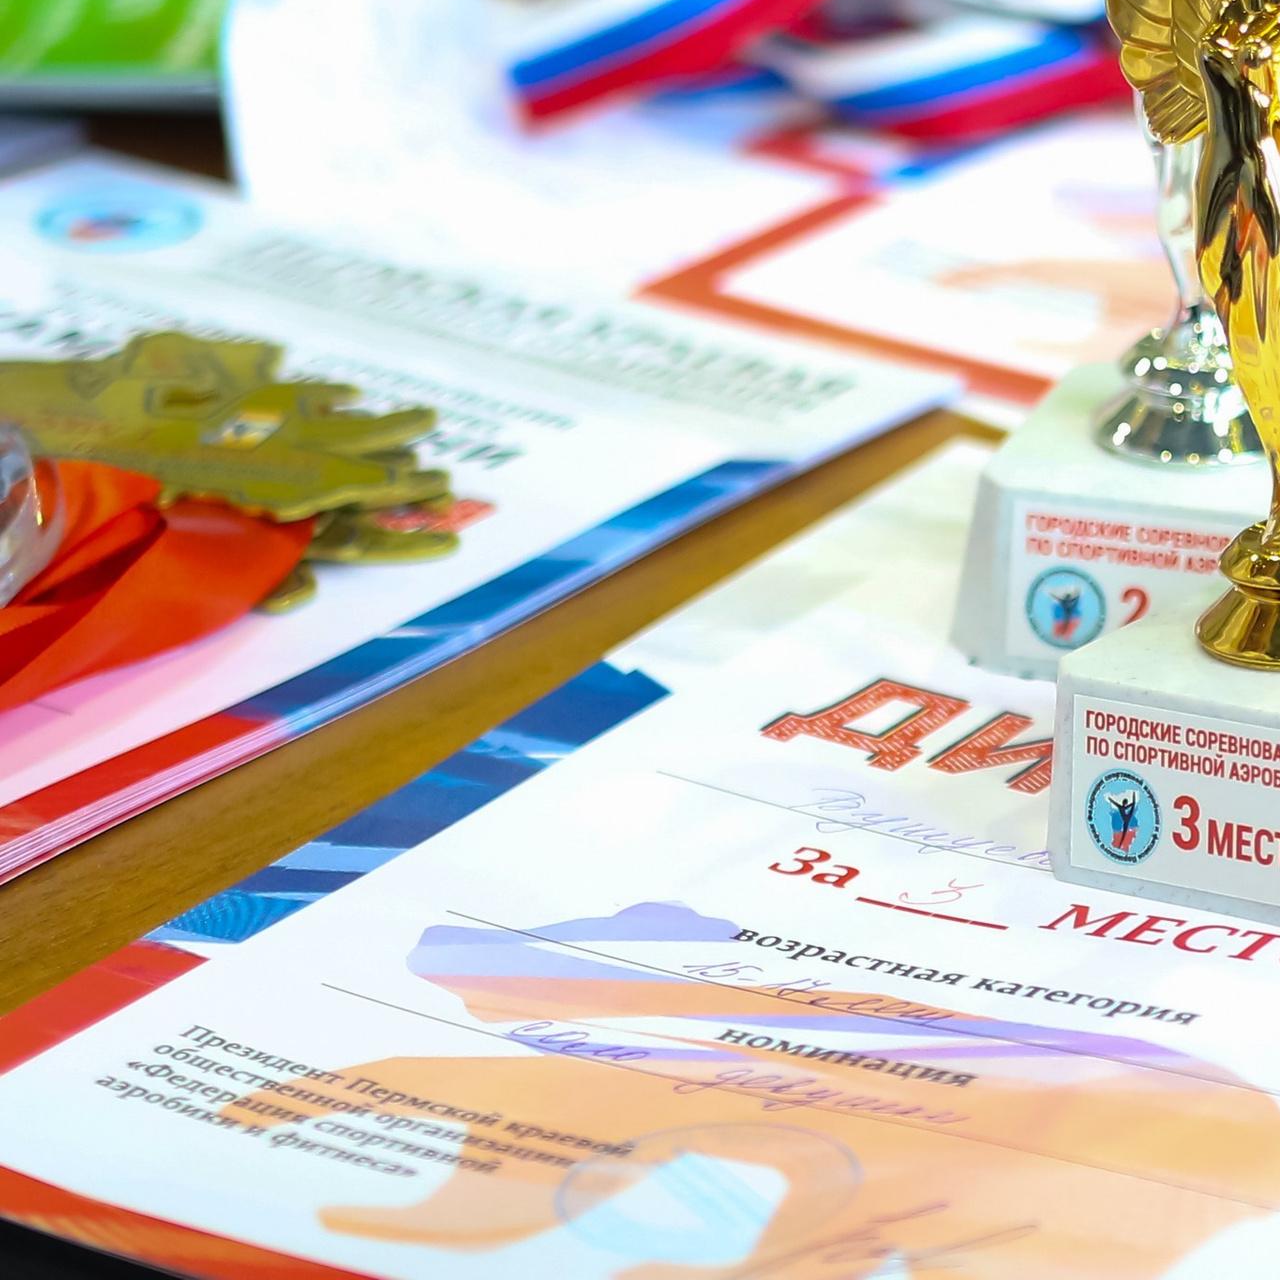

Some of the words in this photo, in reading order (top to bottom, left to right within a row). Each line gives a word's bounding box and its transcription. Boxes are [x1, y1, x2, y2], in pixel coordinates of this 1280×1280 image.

[1026, 513, 1131, 542] ГОРОДСКИЕ
[1026, 537, 1053, 556] ПО
[1056, 541, 1180, 570] СПОРТИВНОЙ
[1120, 585, 1151, 627] 2
[1086, 710, 1181, 744] ГОРОДСКИЕ
[1087, 736, 1109, 756] ПО
[1114, 741, 1224, 778] СПОРТИВНОЙ
[1172, 795, 1200, 851] 3
[768, 846, 860, 888] За
[731, 929, 966, 985] возрастная
[970, 970, 1203, 1026] категория
[154, 1043, 379, 1118] общественной
[718, 1028, 978, 1088] номинация
[95, 1074, 241, 1130] аэробики
[241, 1124, 268, 1139] и
[127, 1059, 312, 1124] «Федерация
[313, 1118, 502, 1174] спортивной
[178, 1024, 344, 1085] Президент
[345, 1076, 502, 1127] Пермской
[503, 1120, 637, 1157] краевой
